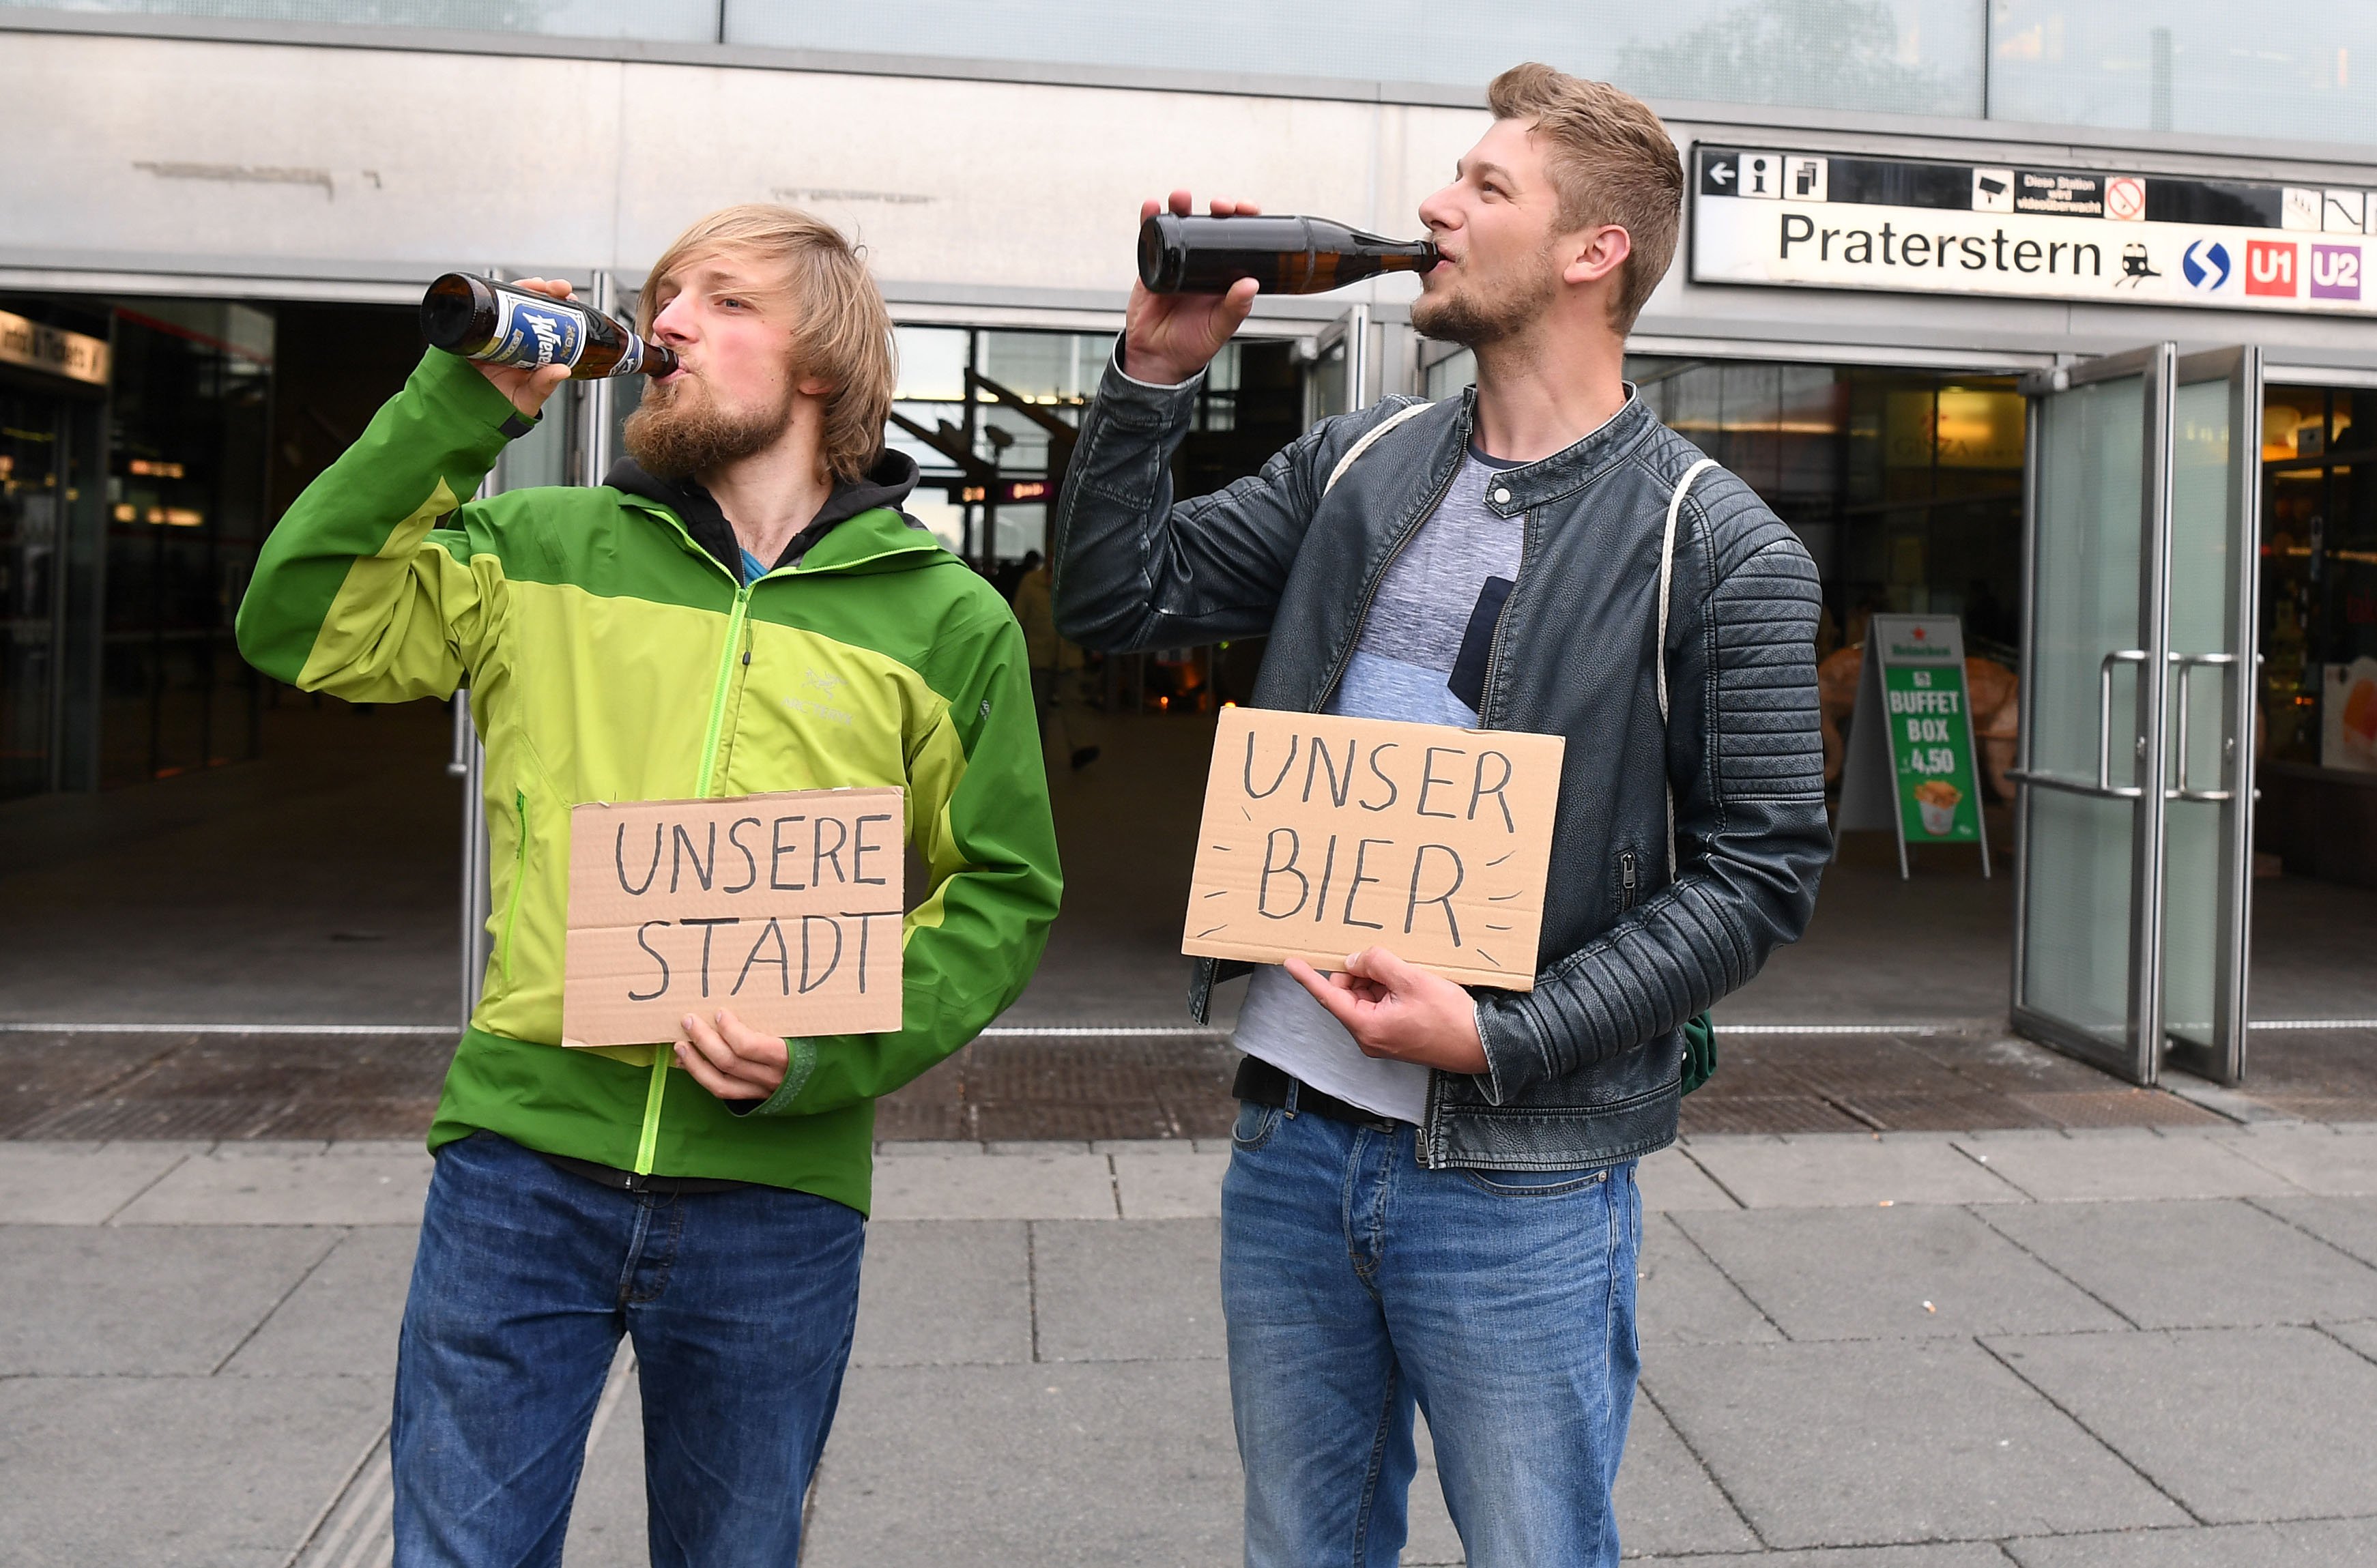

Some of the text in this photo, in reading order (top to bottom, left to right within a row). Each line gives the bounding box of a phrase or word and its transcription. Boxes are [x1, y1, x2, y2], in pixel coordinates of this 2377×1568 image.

[2023, 174, 2096, 191] Diese Station
[2047, 189, 2073, 201] wird
[2017, 196, 2102, 214] videoüberwacht
[1780, 213, 2101, 276] Praterstern
[2252, 248, 2292, 284] U1
[2313, 251, 2360, 288] U2
[1889, 690, 1959, 714] BUFFET
[1907, 718, 1950, 742] BOX
[1911, 748, 1955, 776] 4,50
[1243, 731, 1515, 834] UNSER
[614, 813, 892, 896] UNSERE
[1257, 827, 1465, 948] BIER
[627, 910, 902, 1001] STADT
